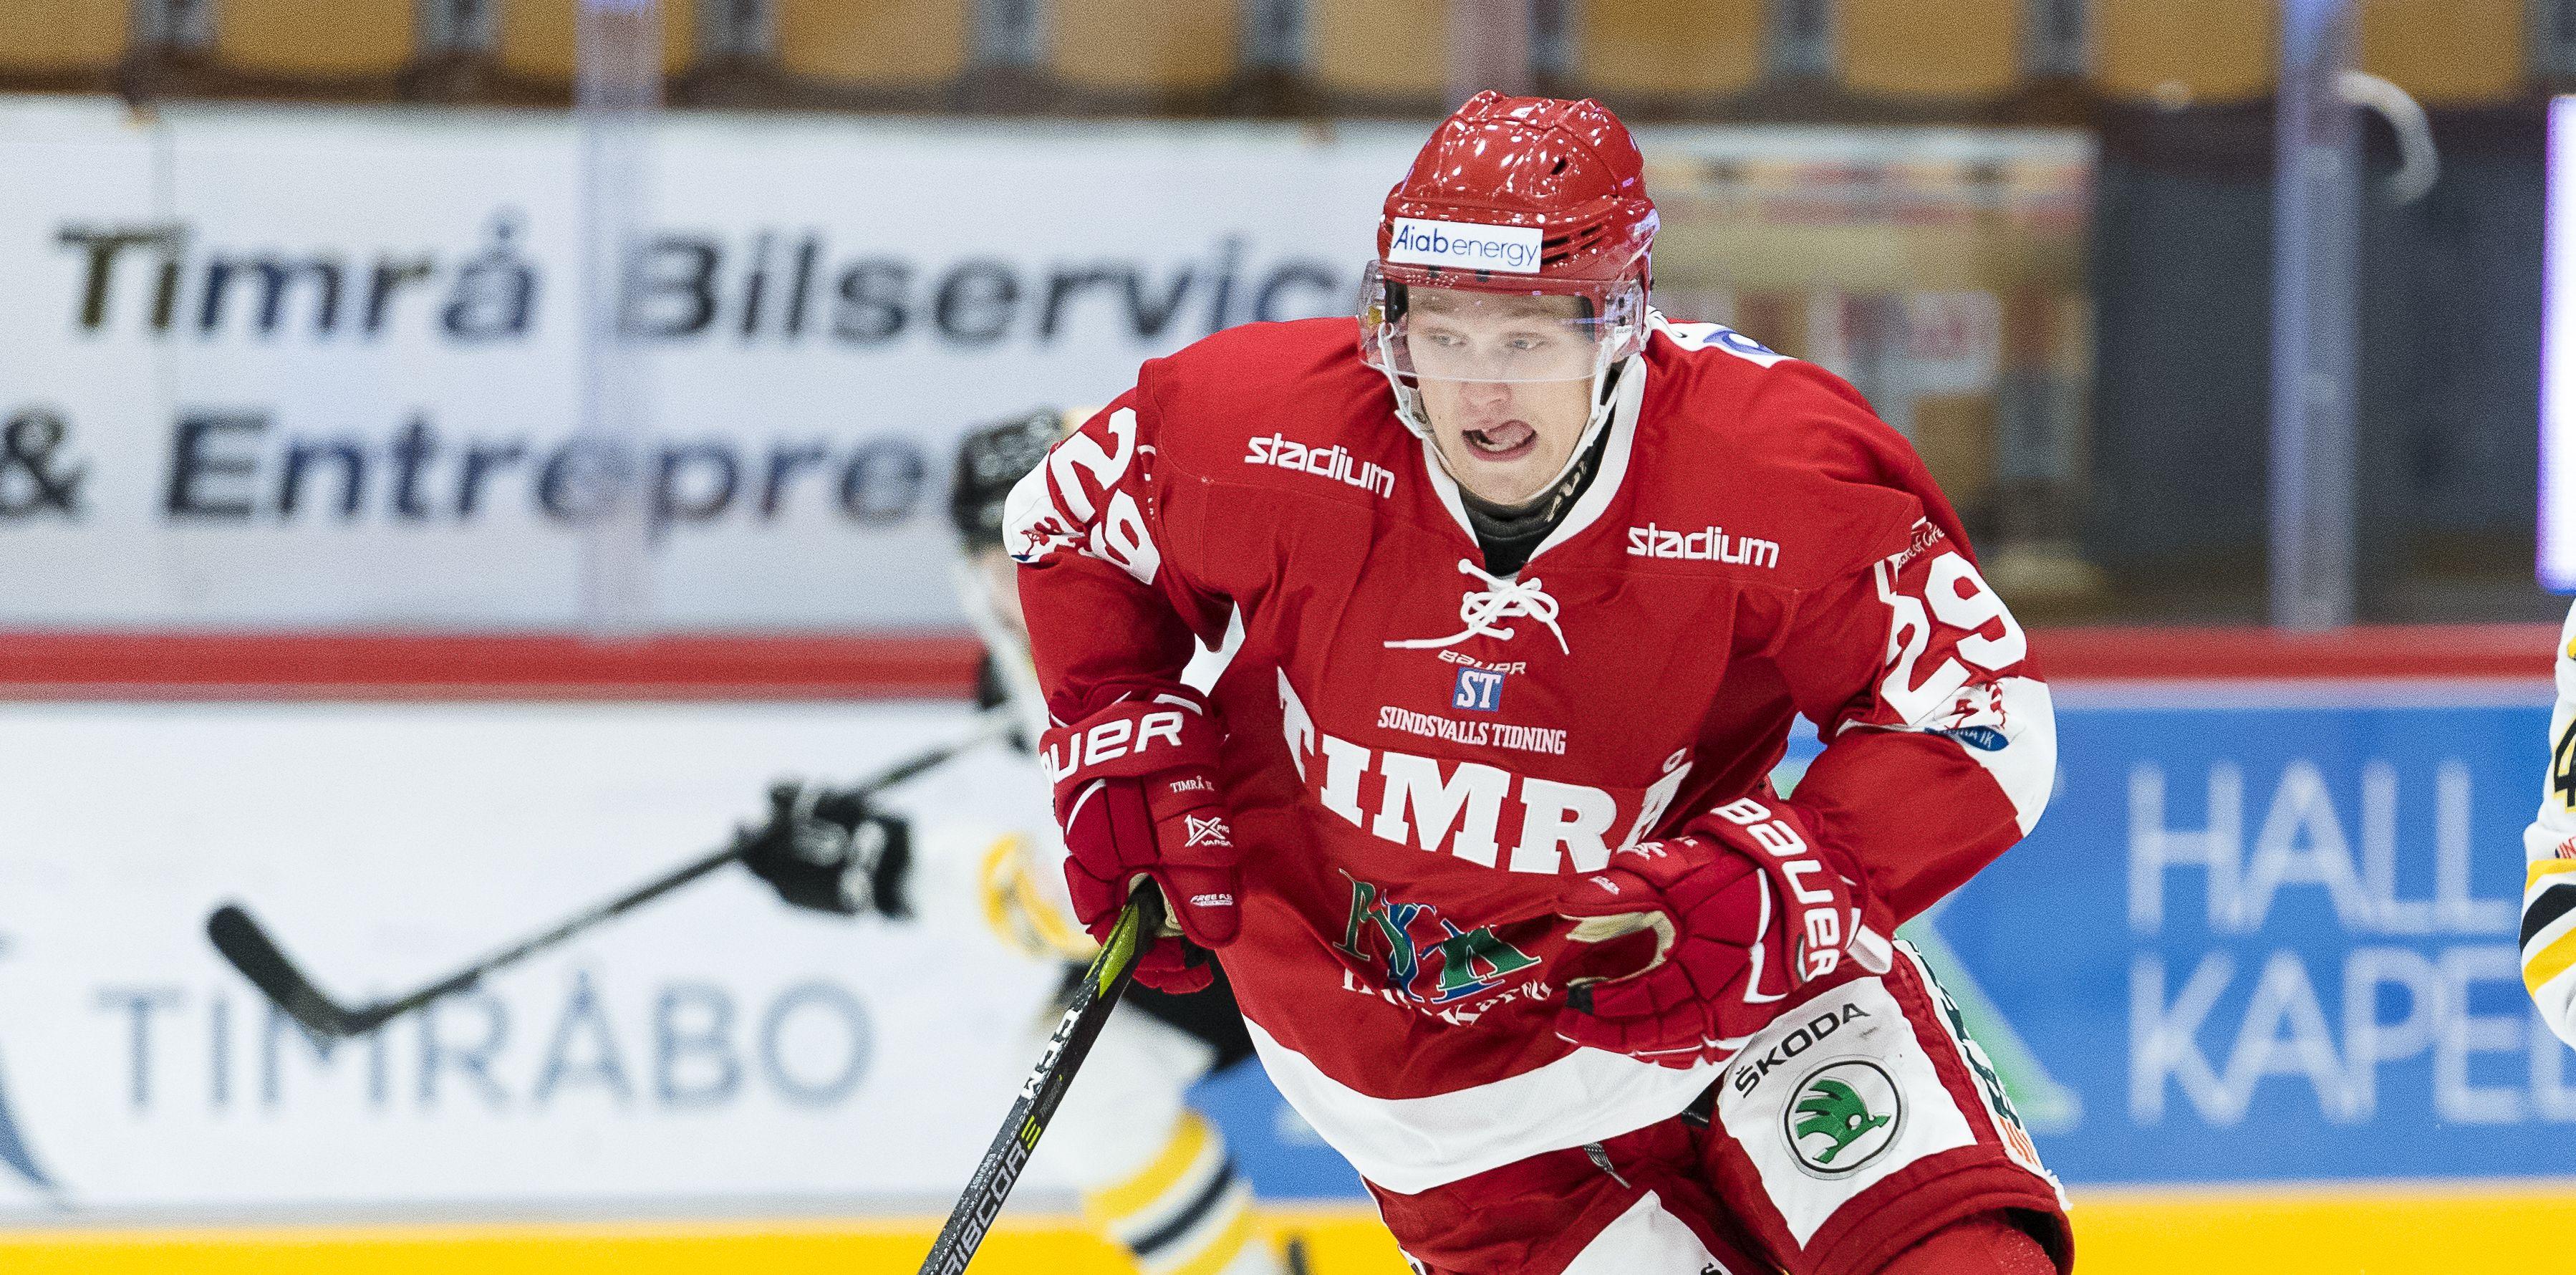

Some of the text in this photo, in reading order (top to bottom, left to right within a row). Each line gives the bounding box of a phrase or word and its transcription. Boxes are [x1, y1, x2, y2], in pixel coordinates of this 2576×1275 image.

[56, 212, 541, 340] Timrå
[0, 408, 87, 521] &
[1244, 432, 1395, 499] stadium
[1627, 522, 1780, 569] stadium
[1880, 551, 2027, 726] 29
[1378, 706, 1567, 755] SUNDSVALLS TIDNING
[1456, 671, 1501, 708] ST
[2128, 761, 2519, 935] HALL
[95, 968, 877, 1110] TIMRÅBO
[1020, 1008, 1082, 1100] CCM
[1735, 1003, 1871, 1098] ŠKODA
